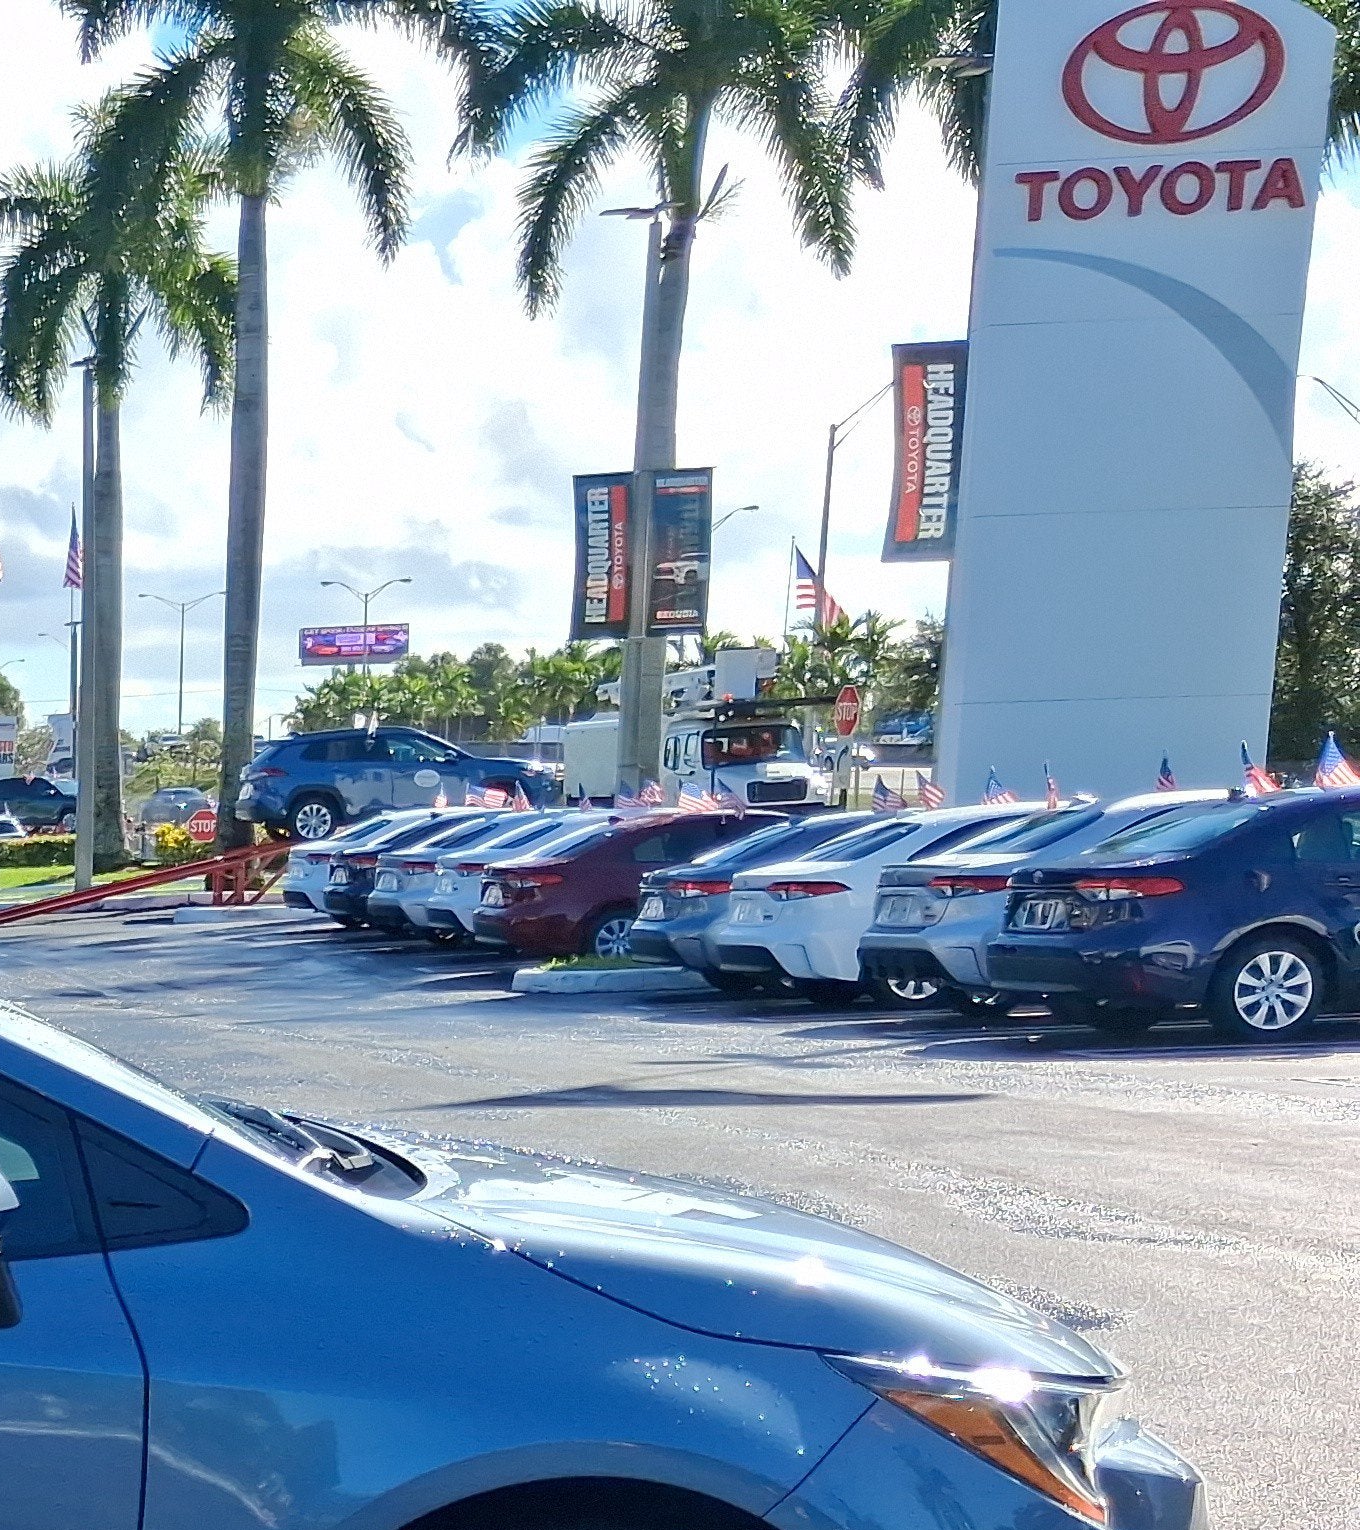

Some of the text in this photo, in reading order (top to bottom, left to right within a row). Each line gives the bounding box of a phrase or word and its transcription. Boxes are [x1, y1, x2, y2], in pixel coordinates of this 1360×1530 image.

[1014, 157, 1306, 222] TOYOTA
[905, 428, 921, 494] TOYOTA
[916, 363, 955, 539] HEADQUARTER
[614, 522, 623, 570] TOYOTA
[837, 702, 858, 720] STOP
